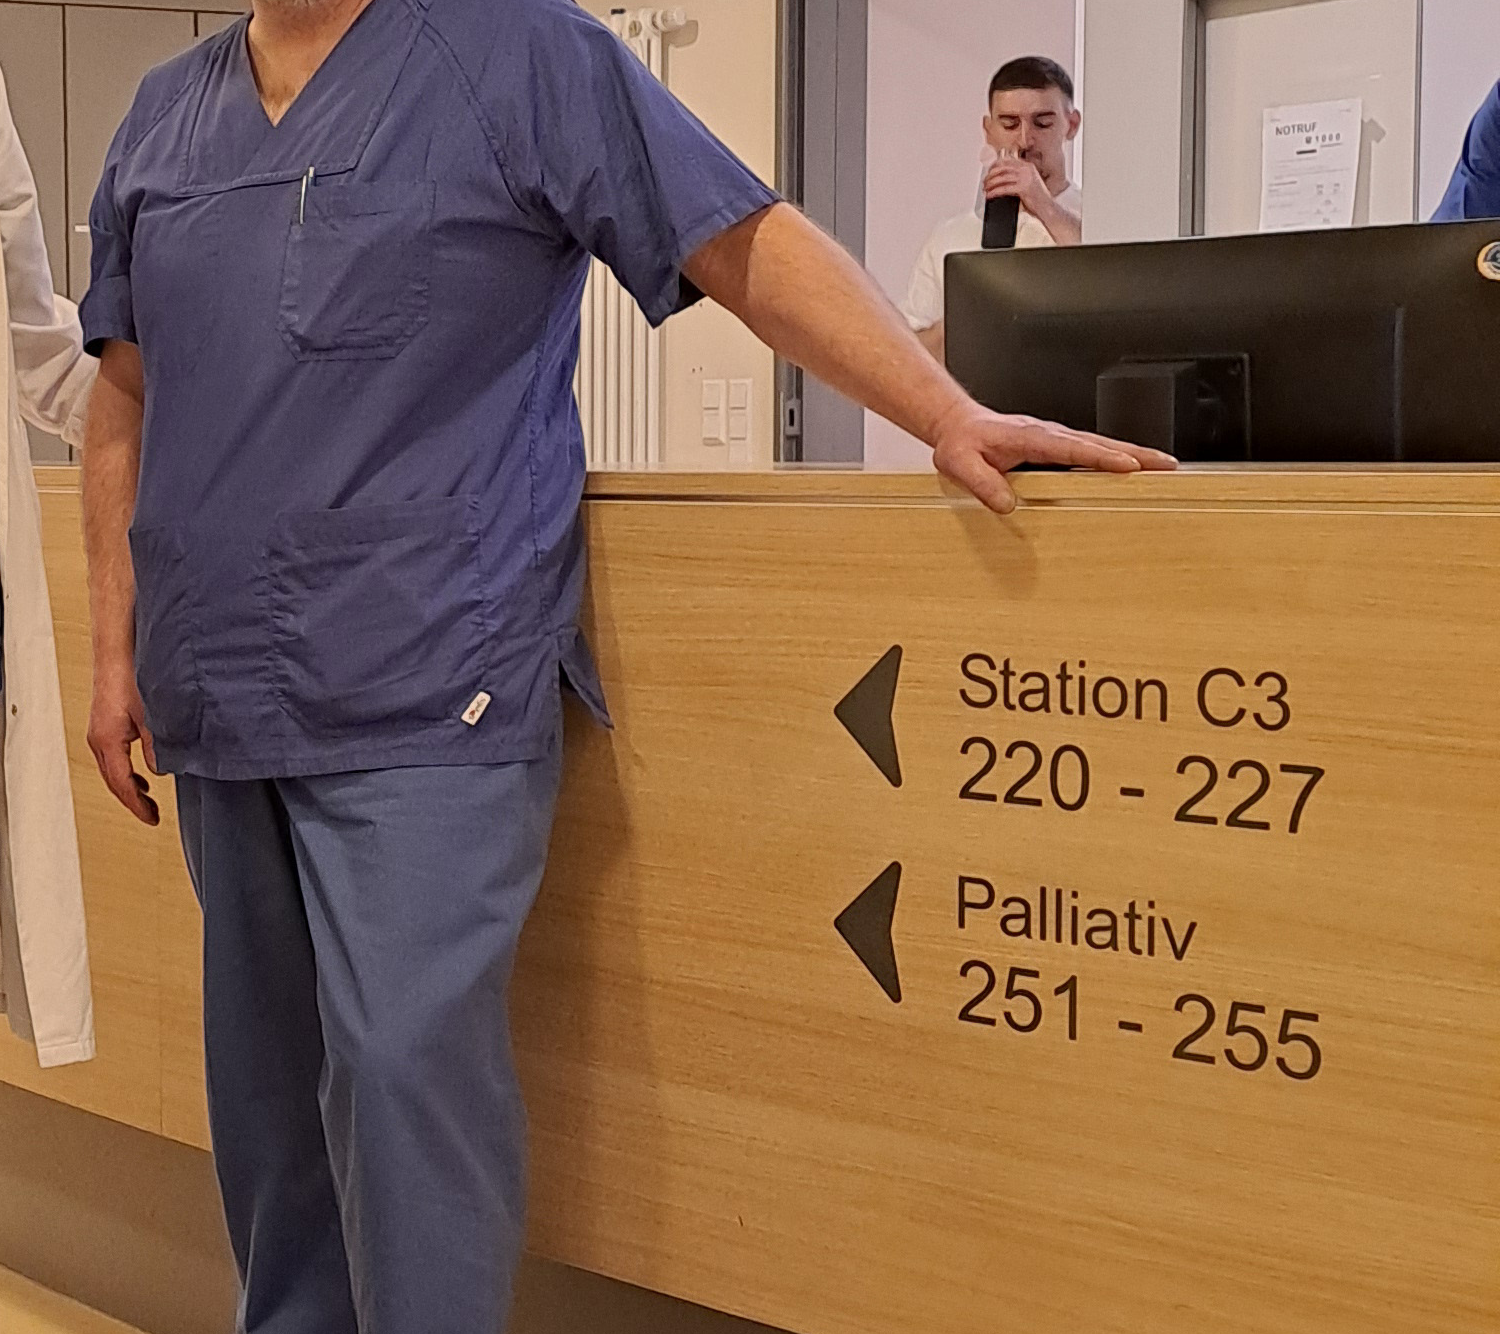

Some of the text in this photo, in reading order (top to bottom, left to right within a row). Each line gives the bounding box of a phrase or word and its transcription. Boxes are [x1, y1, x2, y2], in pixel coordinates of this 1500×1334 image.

[1275, 122, 1317, 136] NOTRUF
[958, 652, 1292, 732] Station C3
[958, 736, 1326, 835] 220 - 227
[957, 874, 1198, 961] Palliativ
[957, 959, 1323, 1081] 251 - 255
